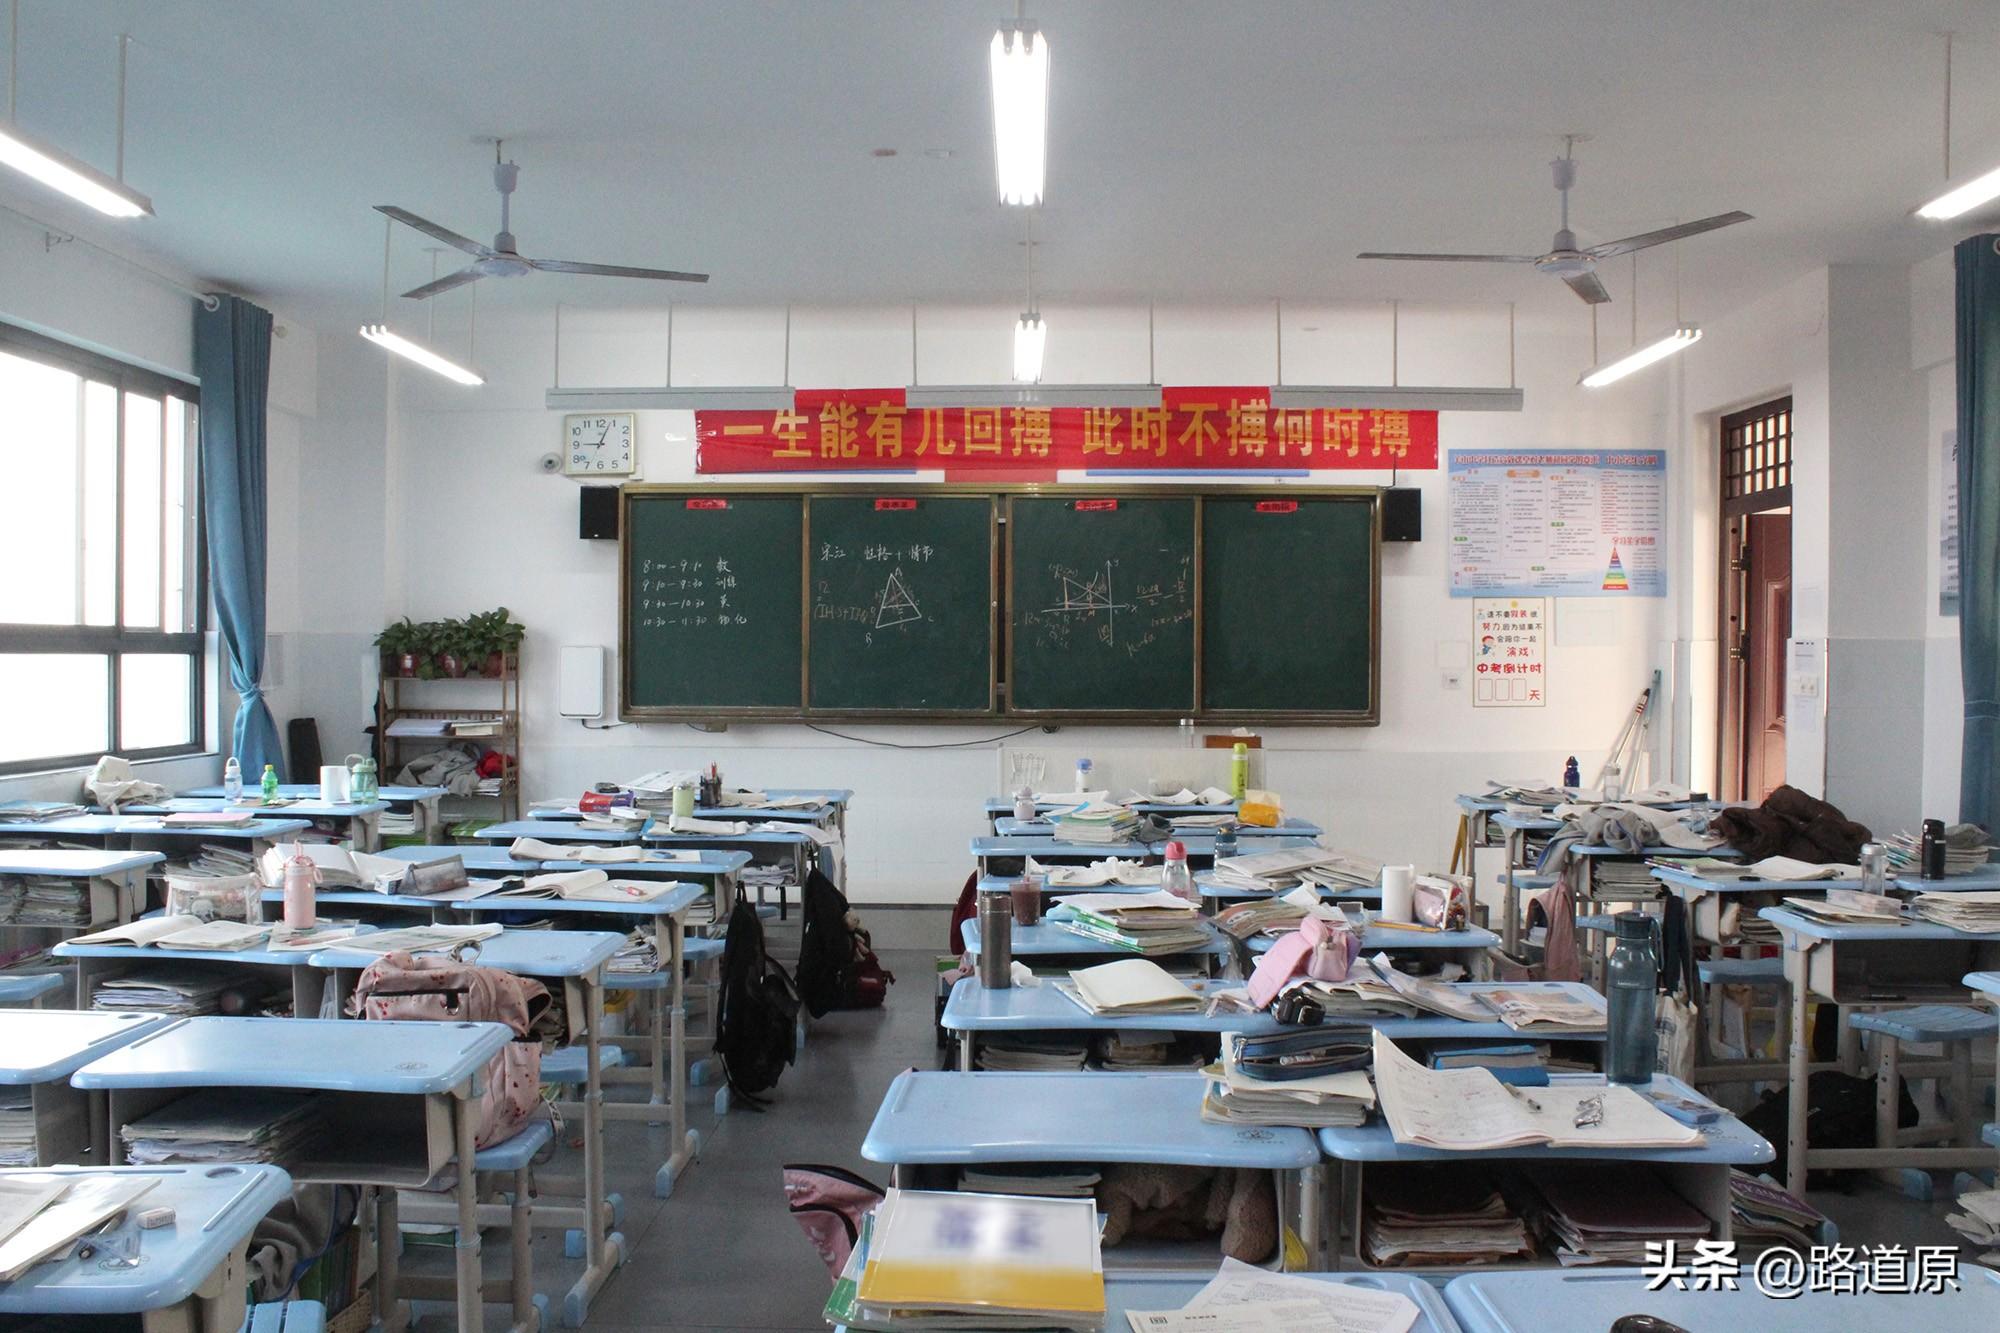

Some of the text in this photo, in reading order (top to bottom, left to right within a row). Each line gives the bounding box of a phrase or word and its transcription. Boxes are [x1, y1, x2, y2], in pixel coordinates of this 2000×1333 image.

[583, 420, 591, 428] 11
[596, 419, 607, 428] 12
[572, 427, 582, 436] 10
[622, 425, 629, 435] 2
[723, 399, 1412, 458] 一生能有几回搏 此时不搏何时搏
[572, 440, 580, 450] 9
[622, 439, 630, 448] 3
[573, 455, 580, 464] 8
[622, 452, 629, 461] 4
[584, 461, 590, 470] 7
[596, 460, 604, 470] 6
[611, 460, 619, 469] 5
[1476, 663, 1543, 674] 中考倒计时
[1529, 689, 1541, 701] 天
